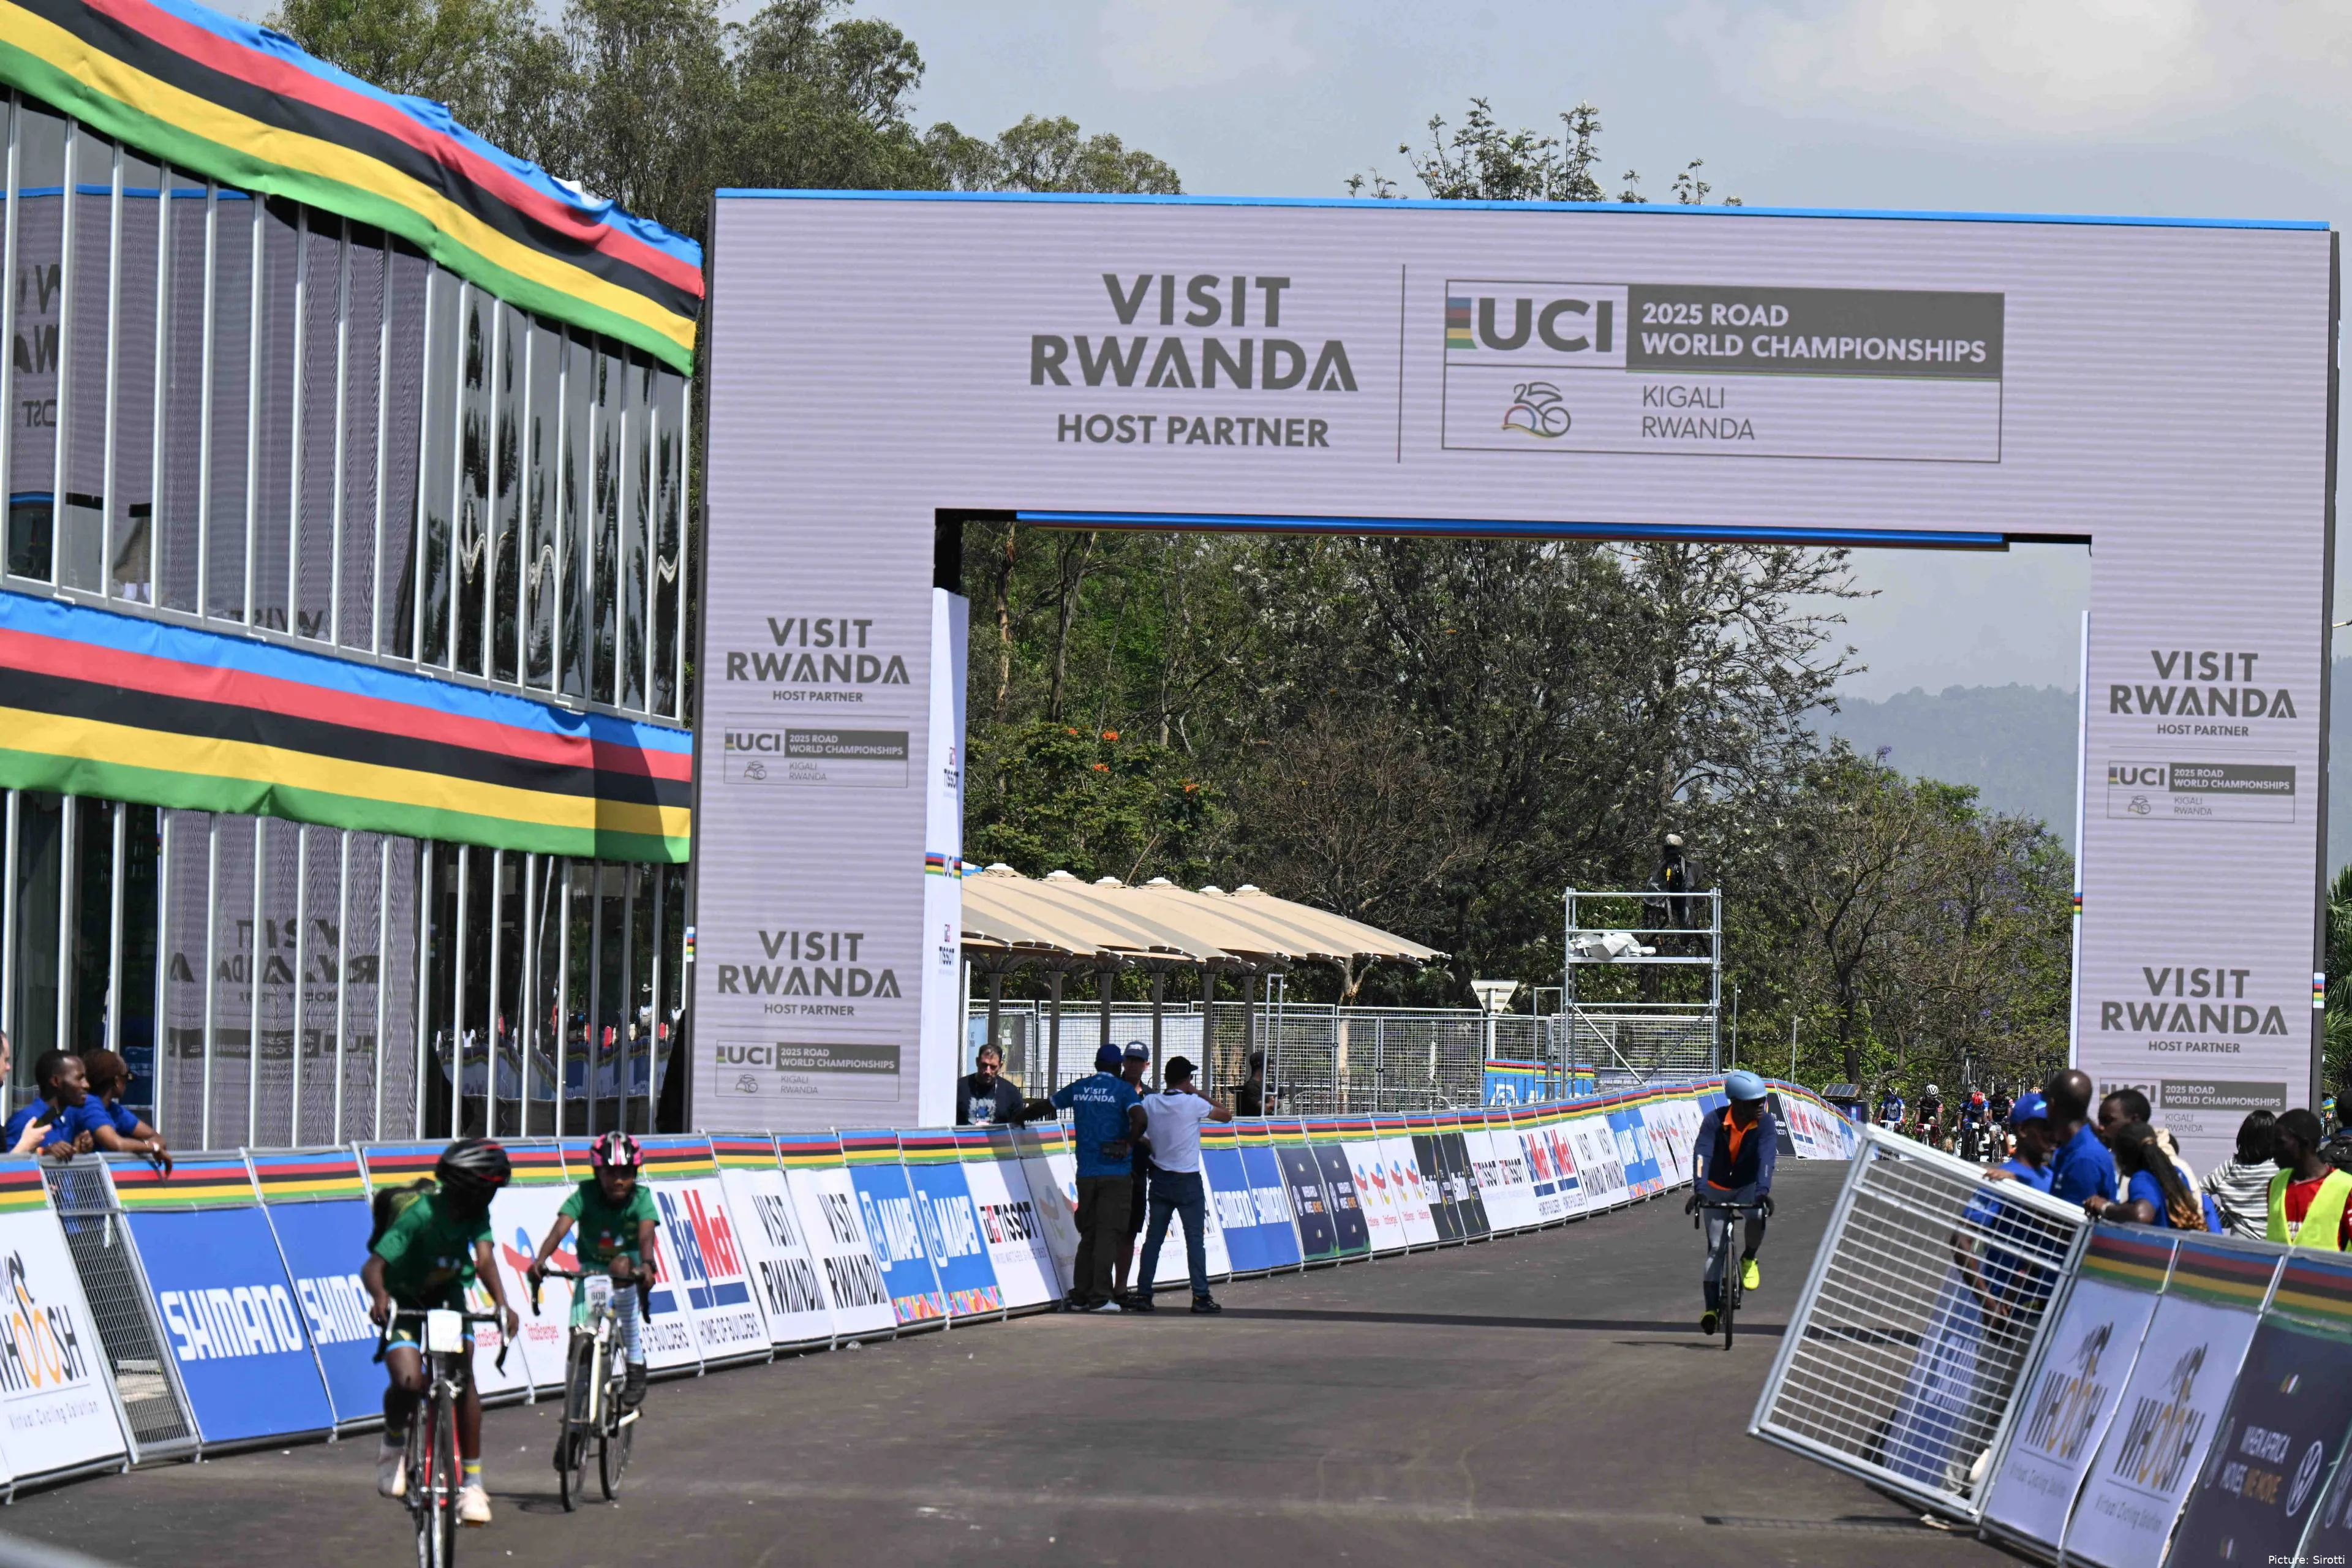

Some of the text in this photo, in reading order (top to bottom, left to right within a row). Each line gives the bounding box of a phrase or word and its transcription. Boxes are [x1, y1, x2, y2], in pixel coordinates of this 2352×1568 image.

[1102, 274, 1290, 327] VISIT
[1479, 298, 1613, 352] UCI
[1643, 303, 1789, 326] 2025 ROAD
[1642, 333, 1986, 362] WORLD CHAMPIONSHIPS
[1031, 335, 1358, 391] RWANDA
[1643, 386, 1725, 409] KIGALI
[1058, 414, 1329, 447] HOST PARTNER
[1642, 416, 1755, 440] RWANDA
[767, 617, 872, 648] VISIT
[727, 652, 910, 684] RWANDA
[2151, 650, 2258, 682] VISIT
[773, 691, 862, 702] HOST PARTNER
[2110, 685, 2296, 718] RWANDA
[790, 734, 810, 743] 2025
[2157, 724, 2248, 736] HOST PARTNER
[736, 733, 780, 752] UCI
[790, 745, 903, 755] WORLD CHAMPIONSHIPS
[789, 762, 817, 771] KIGALI
[789, 772, 827, 781] RWANDA
[2120, 767, 2165, 786] UCI
[2197, 769, 2223, 778] ROAD
[2174, 778, 2290, 790] WORLD CHAMPIONSHIPS
[2174, 796, 2203, 805] KIGALI
[2174, 807, 2212, 816] RWANDA
[759, 931, 864, 961] VISIT
[718, 965, 901, 998] RWANDA
[2143, 967, 2250, 998] VISIT
[764, 1004, 854, 1016] HOST PARTNER
[2101, 1001, 2288, 1035] RWANDA
[728, 1047, 771, 1065] UCI
[781, 1048, 801, 1057] 2025
[2149, 1041, 2240, 1052] HOST PARTNER
[781, 1058, 894, 1069] WORLD CHAMPIONSHIPS
[781, 1076, 809, 1084] KIGALI
[781, 1085, 818, 1094] RWANDA
[1073, 1094, 1115, 1103] RWANDA
[2165, 1096, 2280, 1107] WORLD CHAMPIONSHIPS
[2165, 1114, 2194, 1122] KIGALI
[2165, 1123, 2204, 1132] RWANDA
[817, 1194, 860, 1243] VISIT
[1213, 1190, 1256, 1228] SHIMANO
[752, 1195, 796, 1247] VISIT
[933, 1196, 981, 1258] MAPEI
[993, 1202, 1038, 1241] TISSOT
[657, 1189, 742, 1308] BigMat
[759, 1259, 825, 1315] RWANDA
[824, 1254, 887, 1309] RWANDA
[297, 1273, 383, 1344] SHIMA
[160, 1284, 303, 1361] SHIMANO
